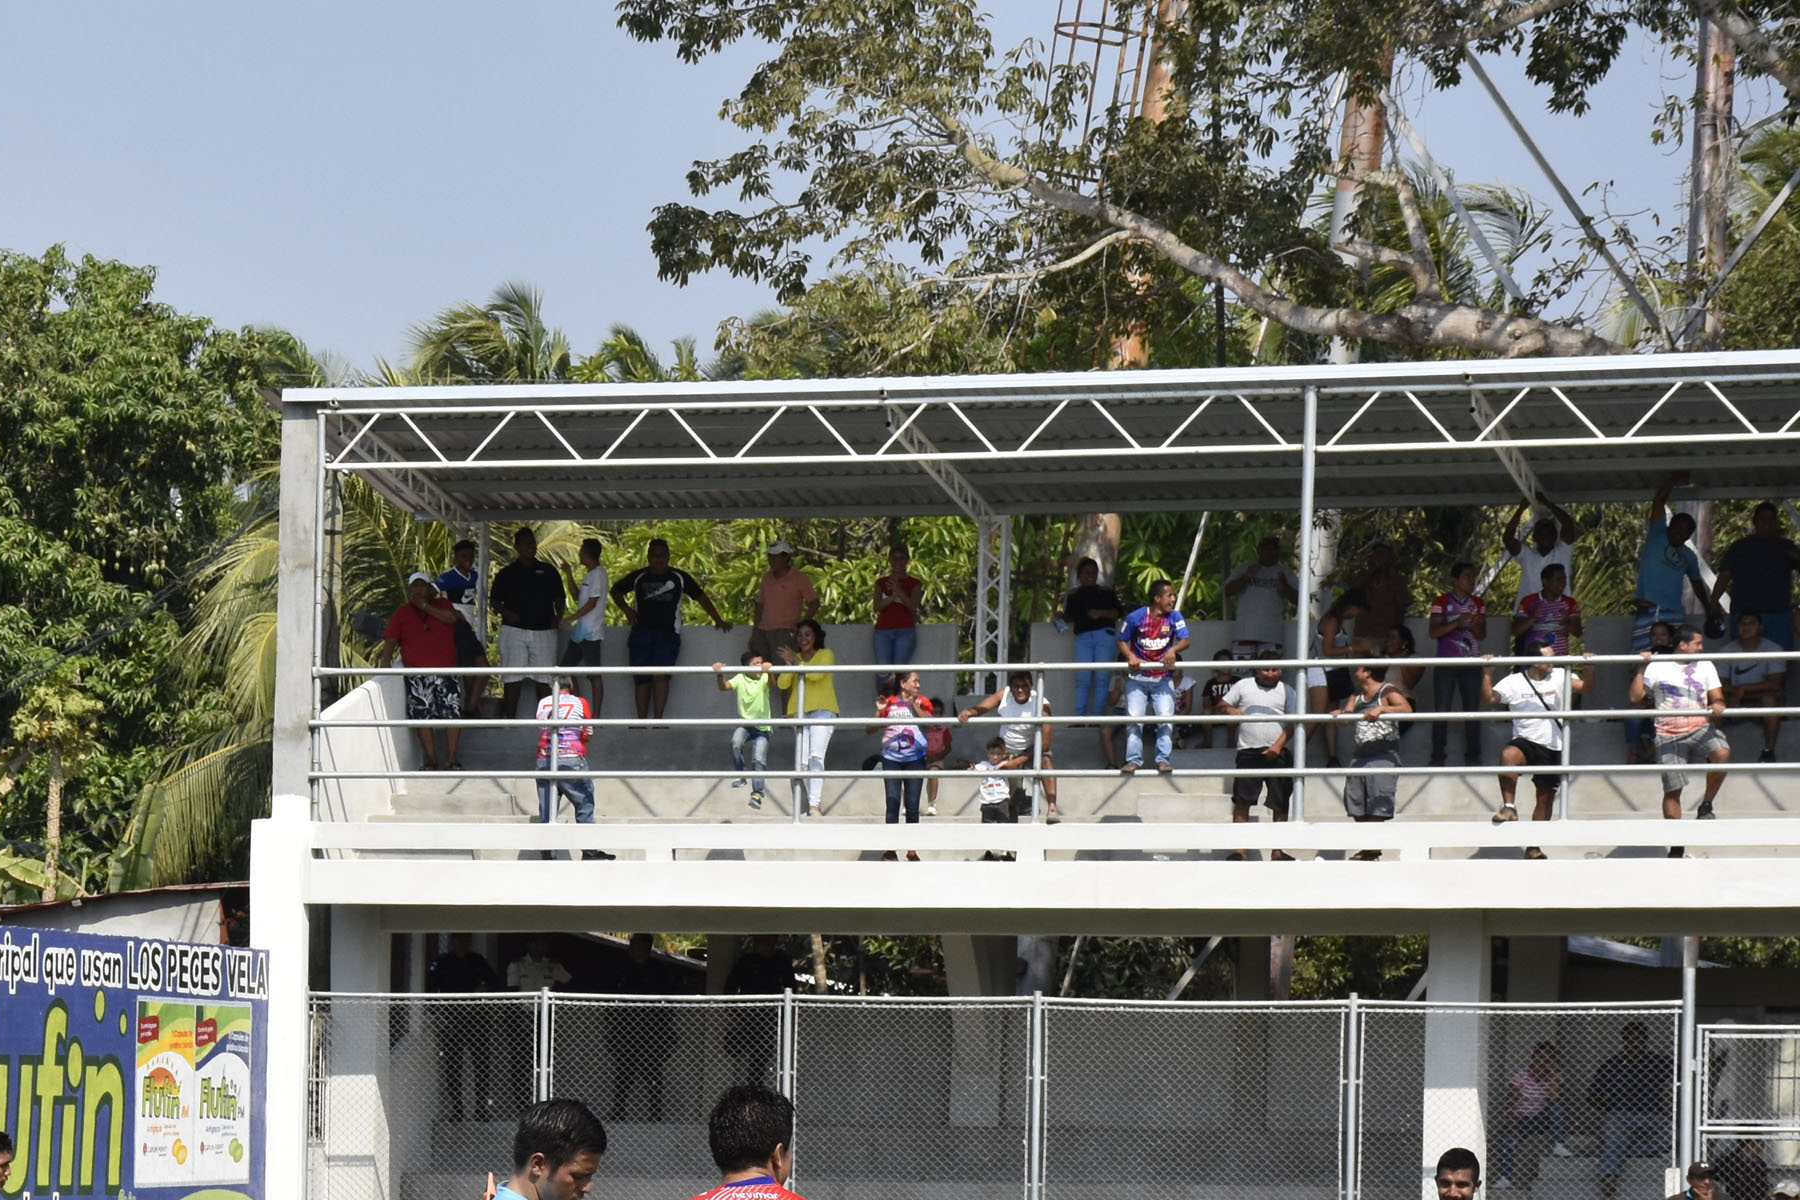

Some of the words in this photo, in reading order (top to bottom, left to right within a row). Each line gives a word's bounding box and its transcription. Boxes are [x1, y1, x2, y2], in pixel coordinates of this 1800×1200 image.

[43, 946, 75, 994] que
[81, 949, 122, 987] usan
[128, 943, 162, 988] LOS
[227, 952, 267, 996] VELA
